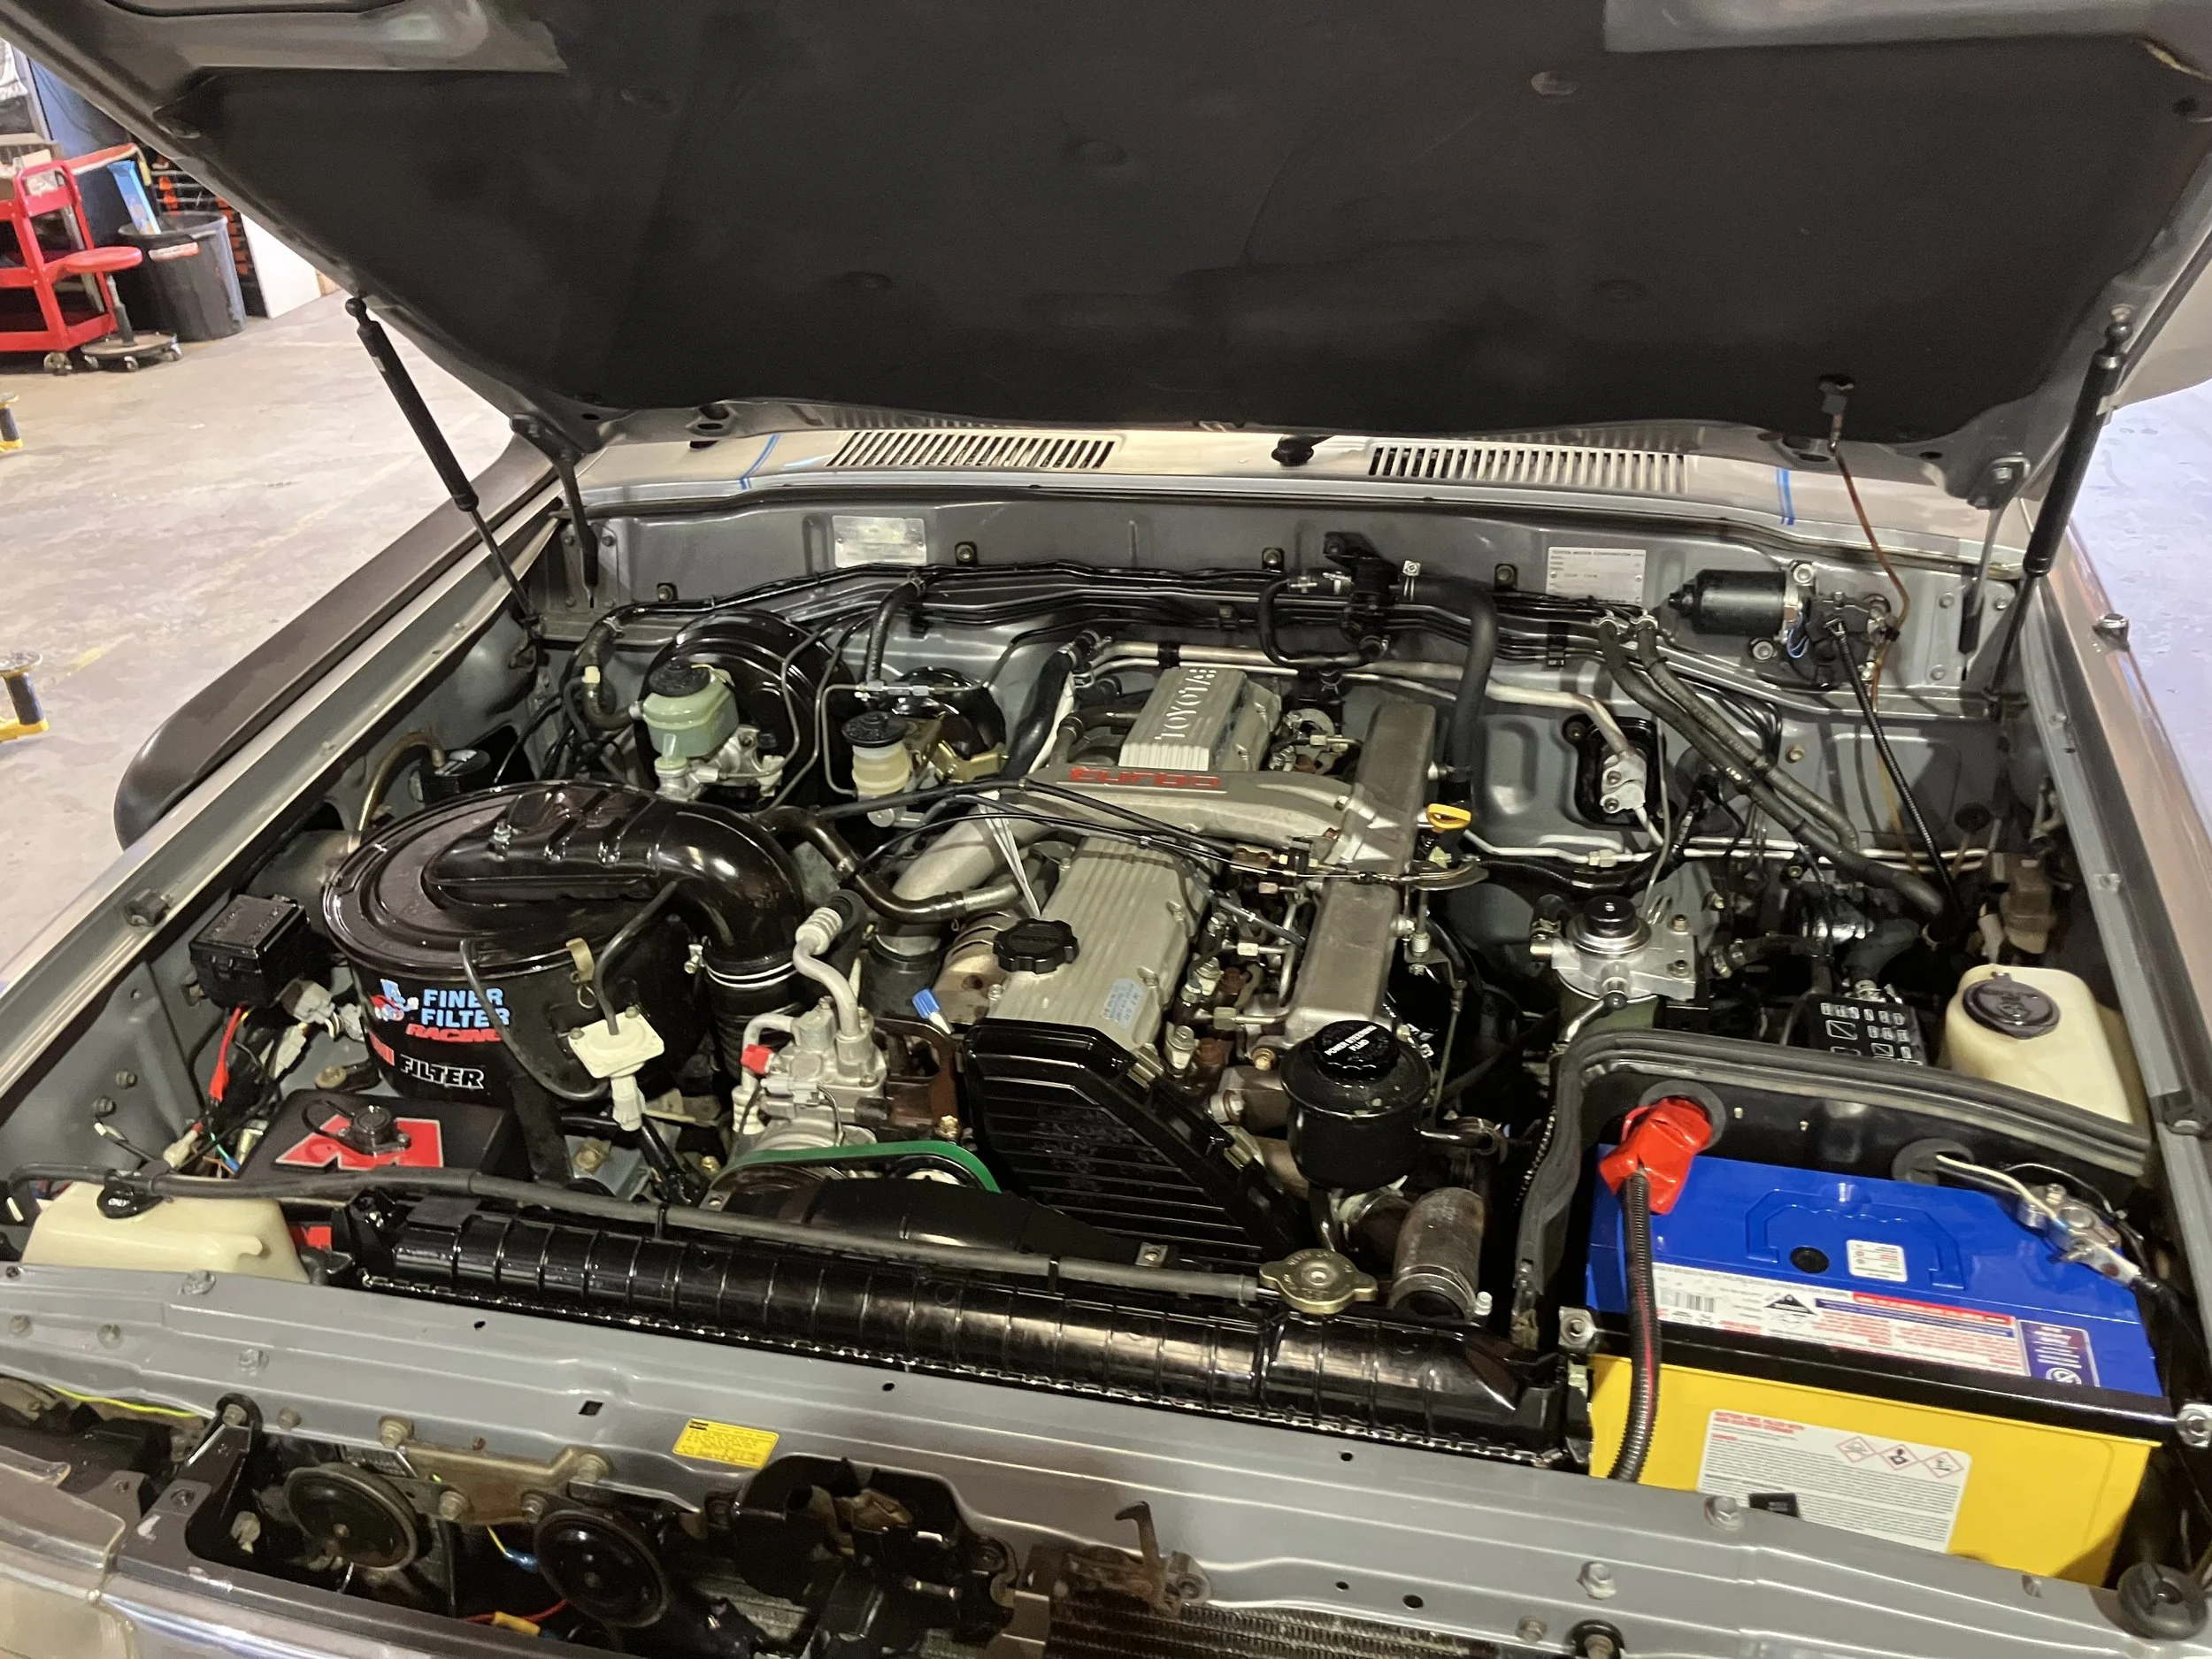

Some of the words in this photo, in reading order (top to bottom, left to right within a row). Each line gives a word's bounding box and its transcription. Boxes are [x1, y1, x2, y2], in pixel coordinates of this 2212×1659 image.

[1154, 669, 1217, 740] TOYOTA
[424, 987, 503, 1009] FINER
[421, 1007, 511, 1028] FILTER
[1324, 1041, 1349, 1056] POWER
[400, 1053, 484, 1089] FILTER
